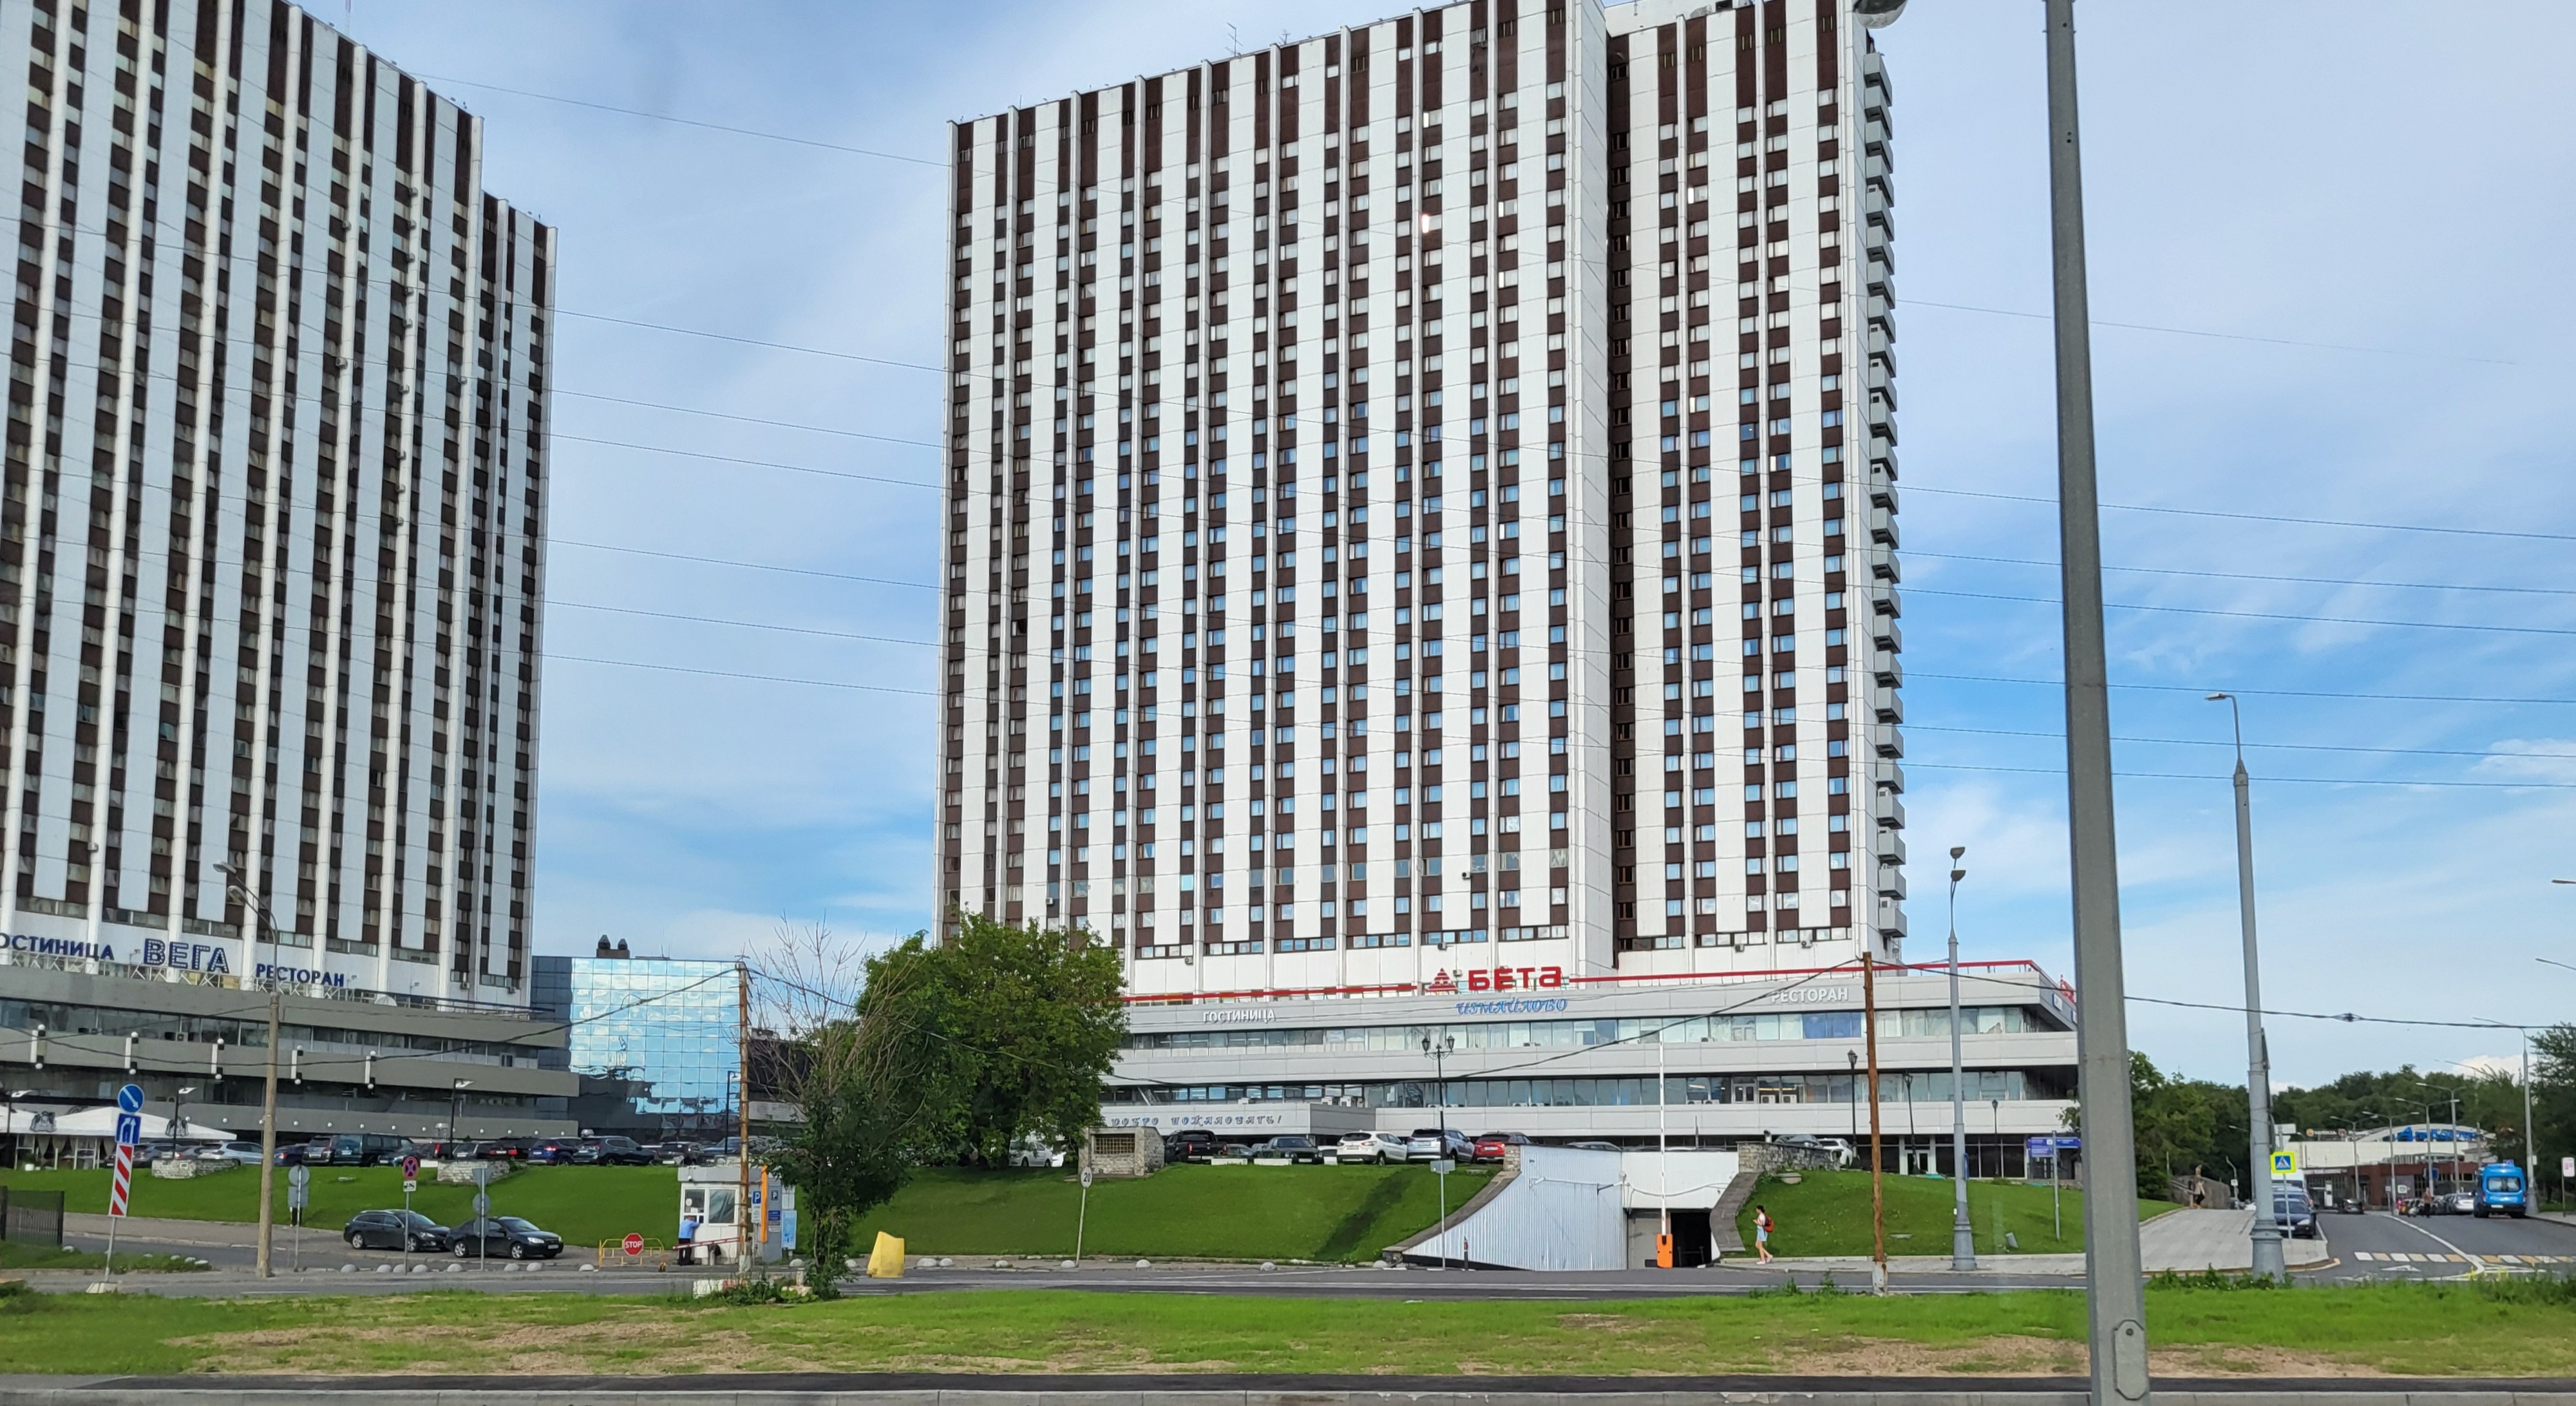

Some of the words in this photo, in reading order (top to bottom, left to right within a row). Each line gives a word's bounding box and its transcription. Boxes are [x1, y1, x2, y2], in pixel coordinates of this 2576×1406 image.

[143, 938, 230, 974] ВЕГА
[256, 963, 345, 988] РЕСТОРАН
[1771, 987, 1848, 1003] РЕСТОРАН
[1455, 998, 1568, 1015] ИЗМАЙЛОВО
[1203, 1009, 1276, 1023] ГОСТИНИЦА
[1083, 1172, 1091, 1183] 20
[754, 1192, 761, 1203] P
